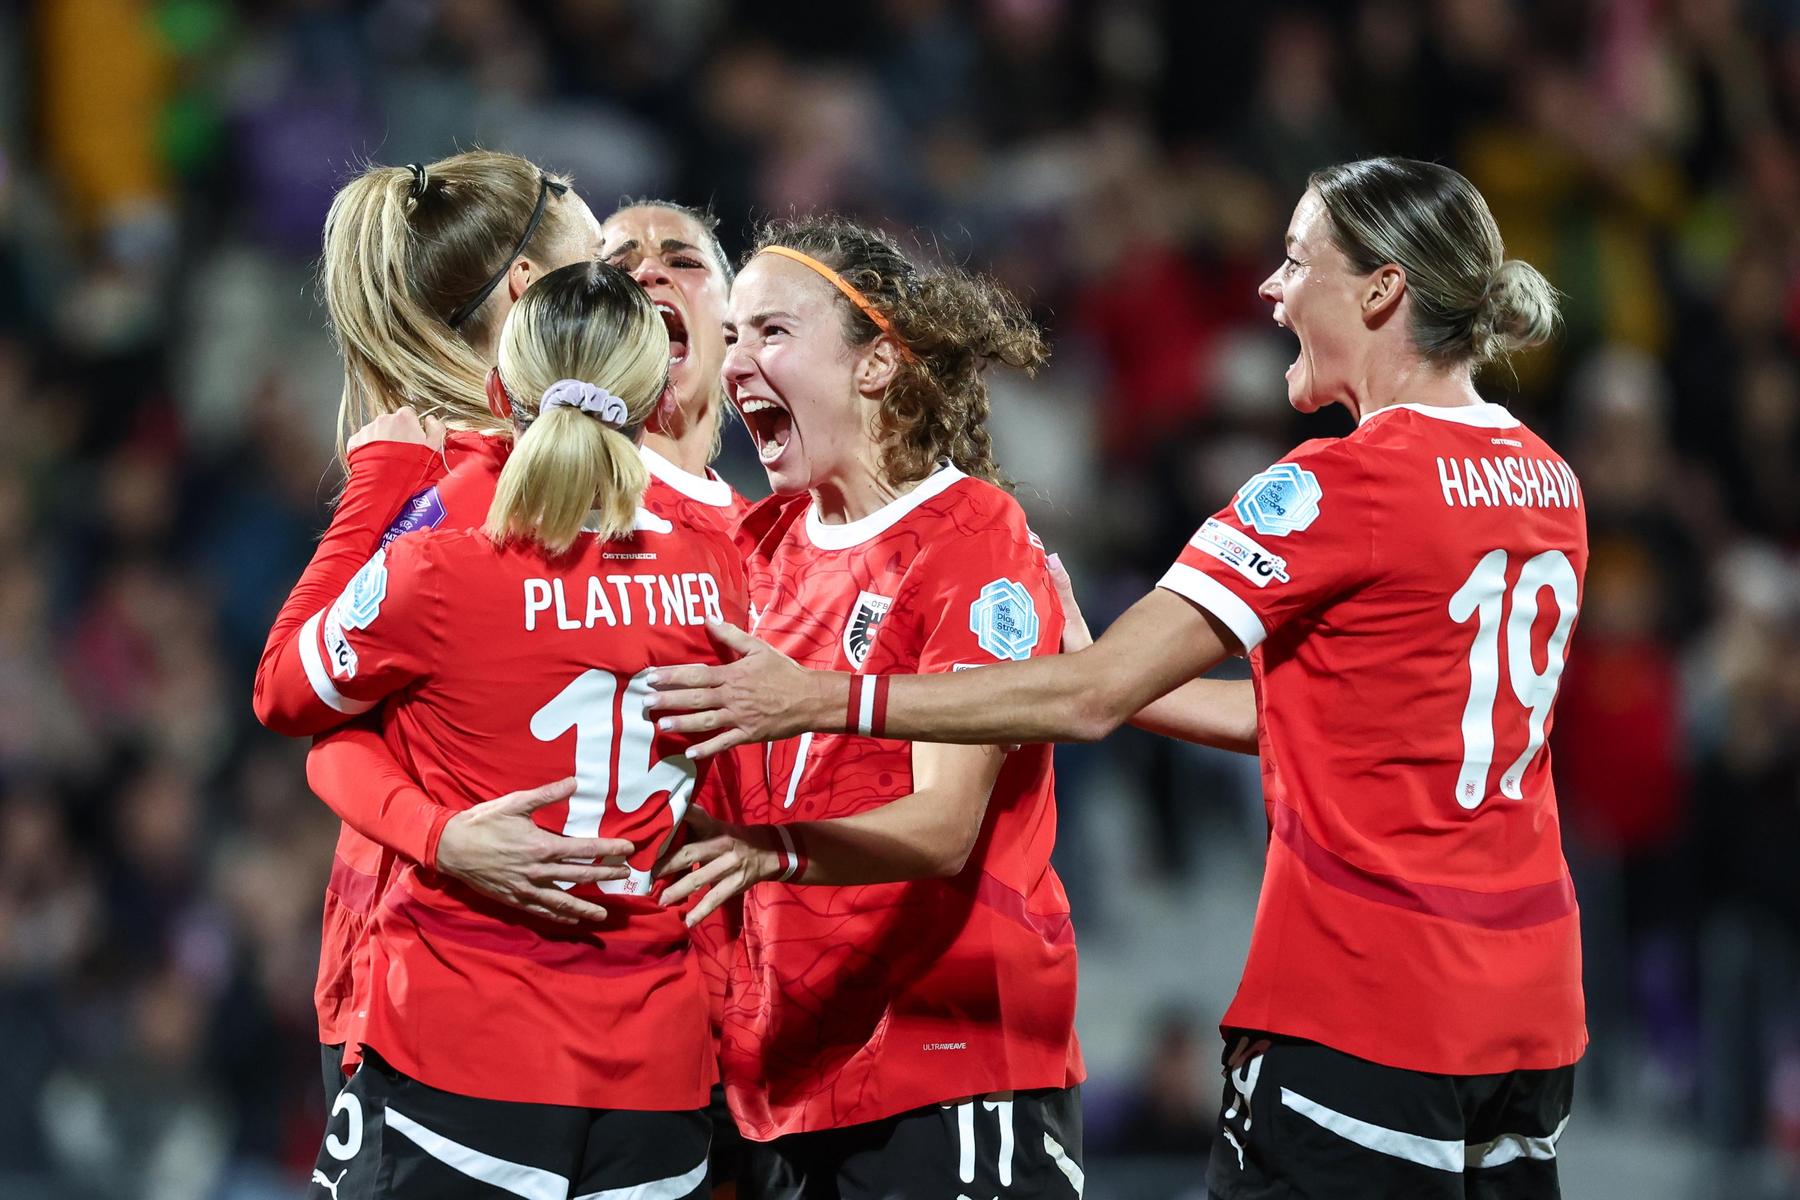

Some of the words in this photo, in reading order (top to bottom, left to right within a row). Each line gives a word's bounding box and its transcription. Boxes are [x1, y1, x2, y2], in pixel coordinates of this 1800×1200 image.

[1437, 456, 1579, 508] HANSHAW
[1248, 553, 1273, 576] 10
[524, 572, 723, 631] PLATTNER
[997, 604, 1010, 613] We
[997, 622, 1022, 638] Strong
[1448, 549, 1578, 809] 19
[530, 664, 708, 895] 15
[922, 1042, 967, 1051] ULTRAWEAVE
